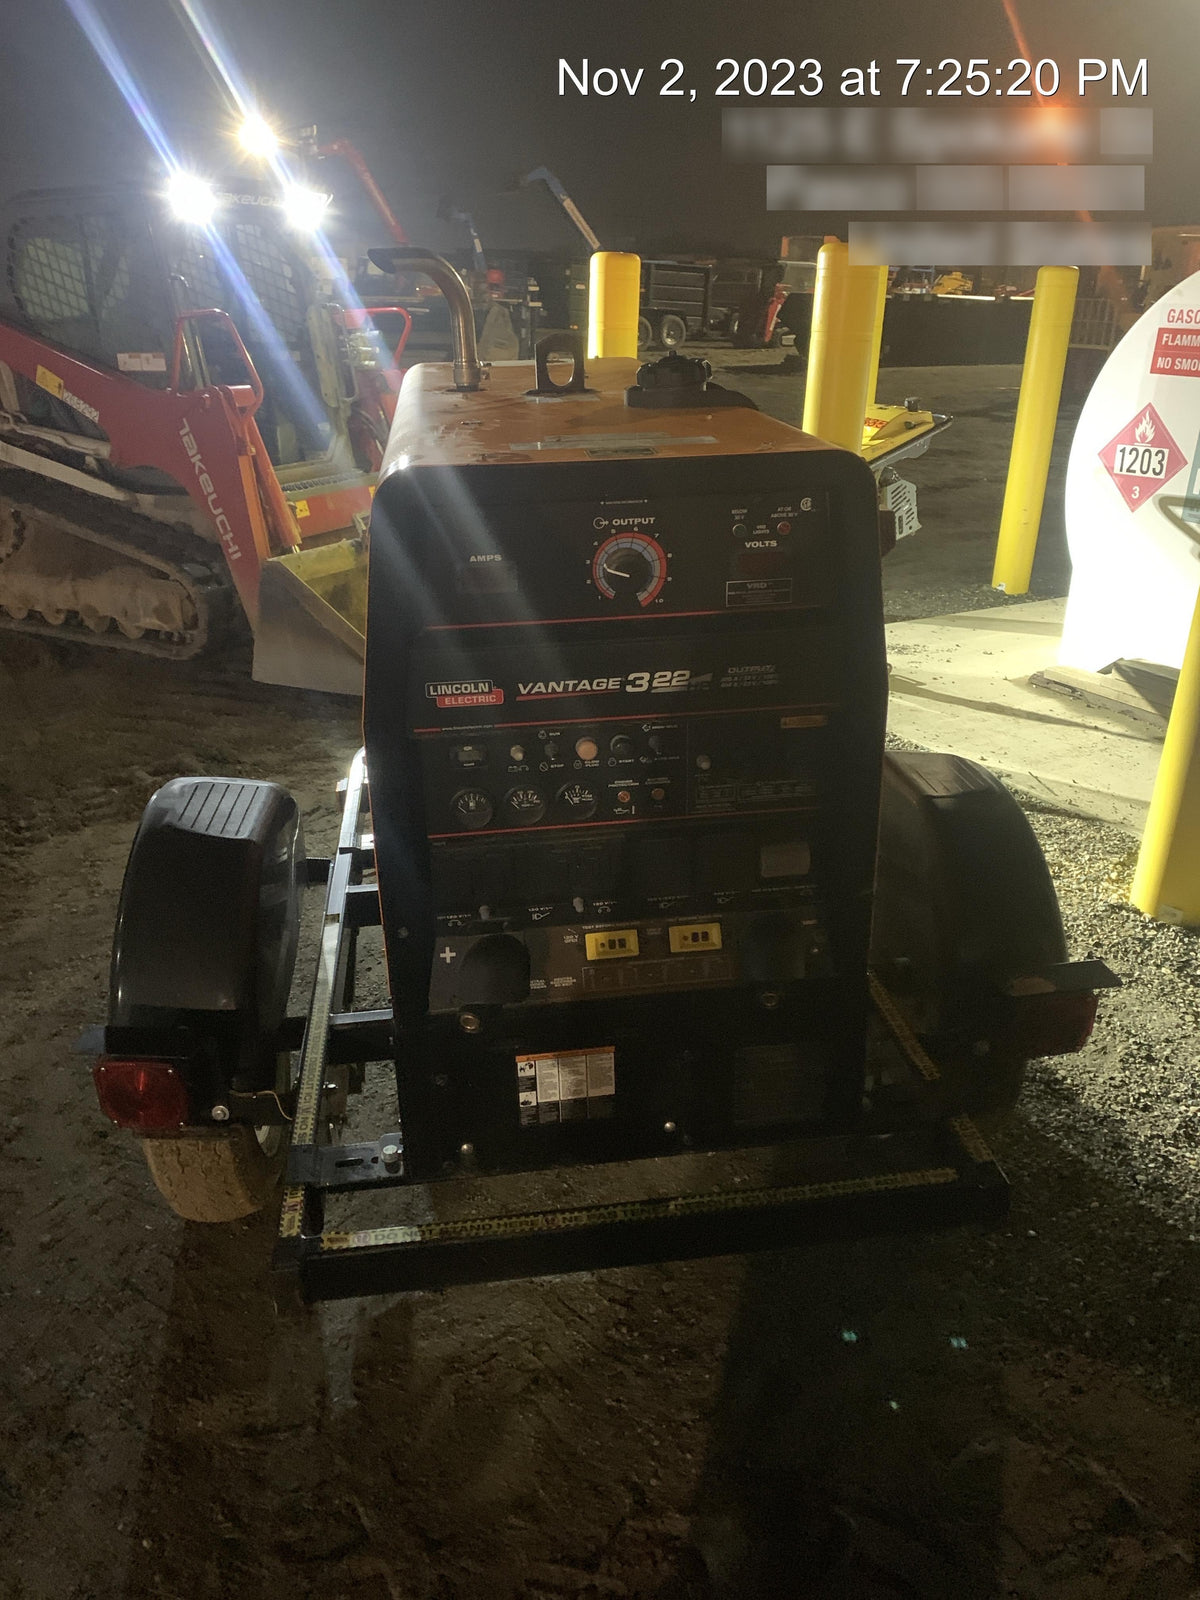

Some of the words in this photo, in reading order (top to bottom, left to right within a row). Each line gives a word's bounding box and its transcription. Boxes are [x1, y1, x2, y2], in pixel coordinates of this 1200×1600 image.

[1157, 356, 1172, 369] NO
[1118, 446, 1166, 476] 1203
[1131, 486, 1140, 499] 3
[612, 517, 655, 526] OUTPUT
[744, 540, 777, 548] VOLTS
[470, 554, 502, 562] AMPS
[517, 676, 623, 695] VANTAGE
[625, 669, 690, 693] 322
[429, 682, 489, 696] LINCOLN
[445, 694, 497, 705] ELECTRIC
[374, 1233, 397, 1242] DO
[402, 1228, 434, 1240] NOT
[439, 1222, 493, 1237] STAND
[497, 1218, 537, 1230] HERE
